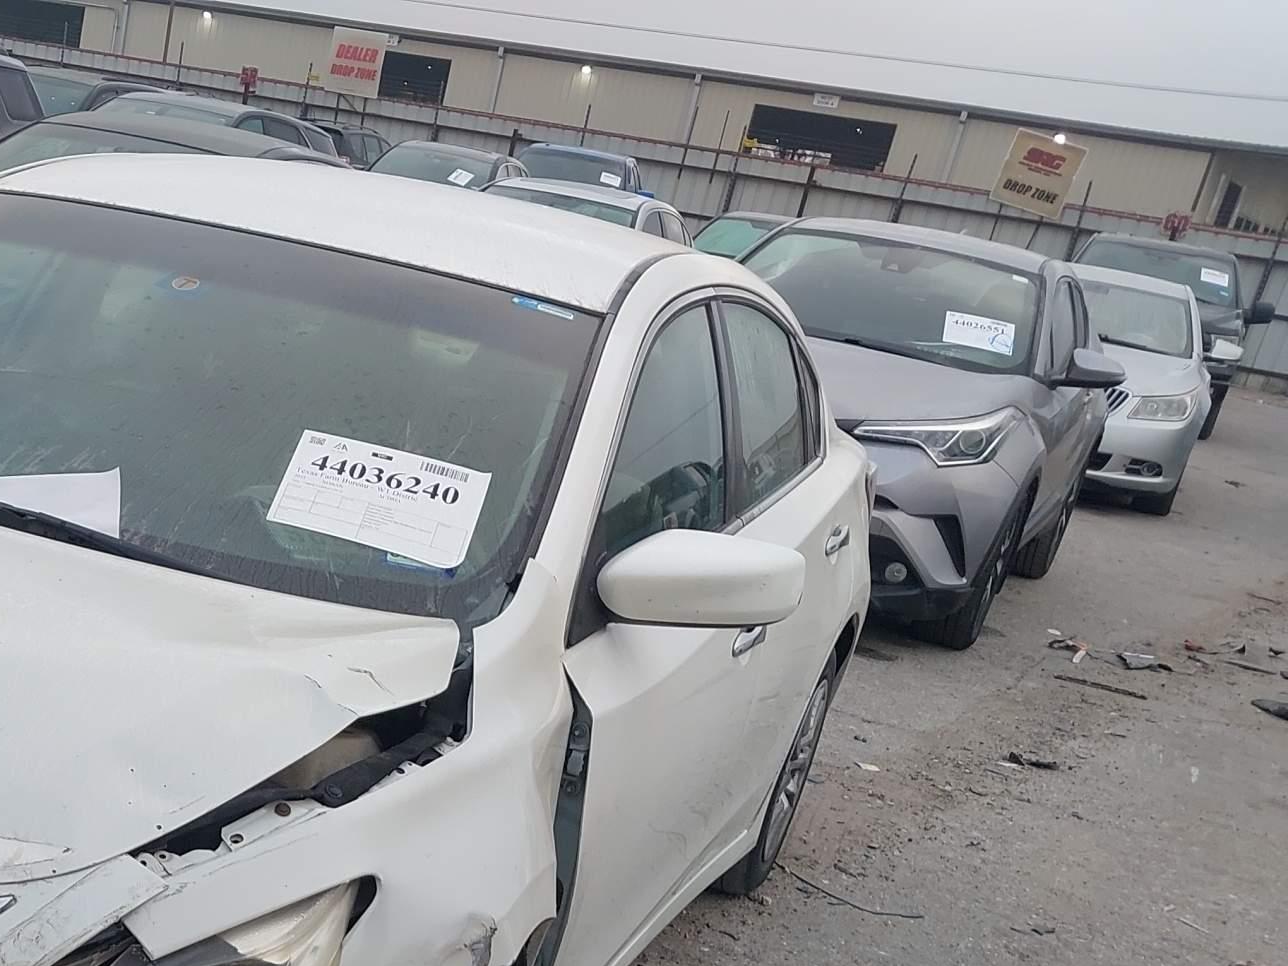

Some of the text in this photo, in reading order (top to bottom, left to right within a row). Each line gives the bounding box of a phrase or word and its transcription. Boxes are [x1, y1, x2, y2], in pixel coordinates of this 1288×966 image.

[335, 43, 380, 63] DEALER
[330, 63, 378, 81] DROP ZONE
[1002, 178, 1059, 204] DROP ZONE
[311, 455, 459, 504] 44036240
